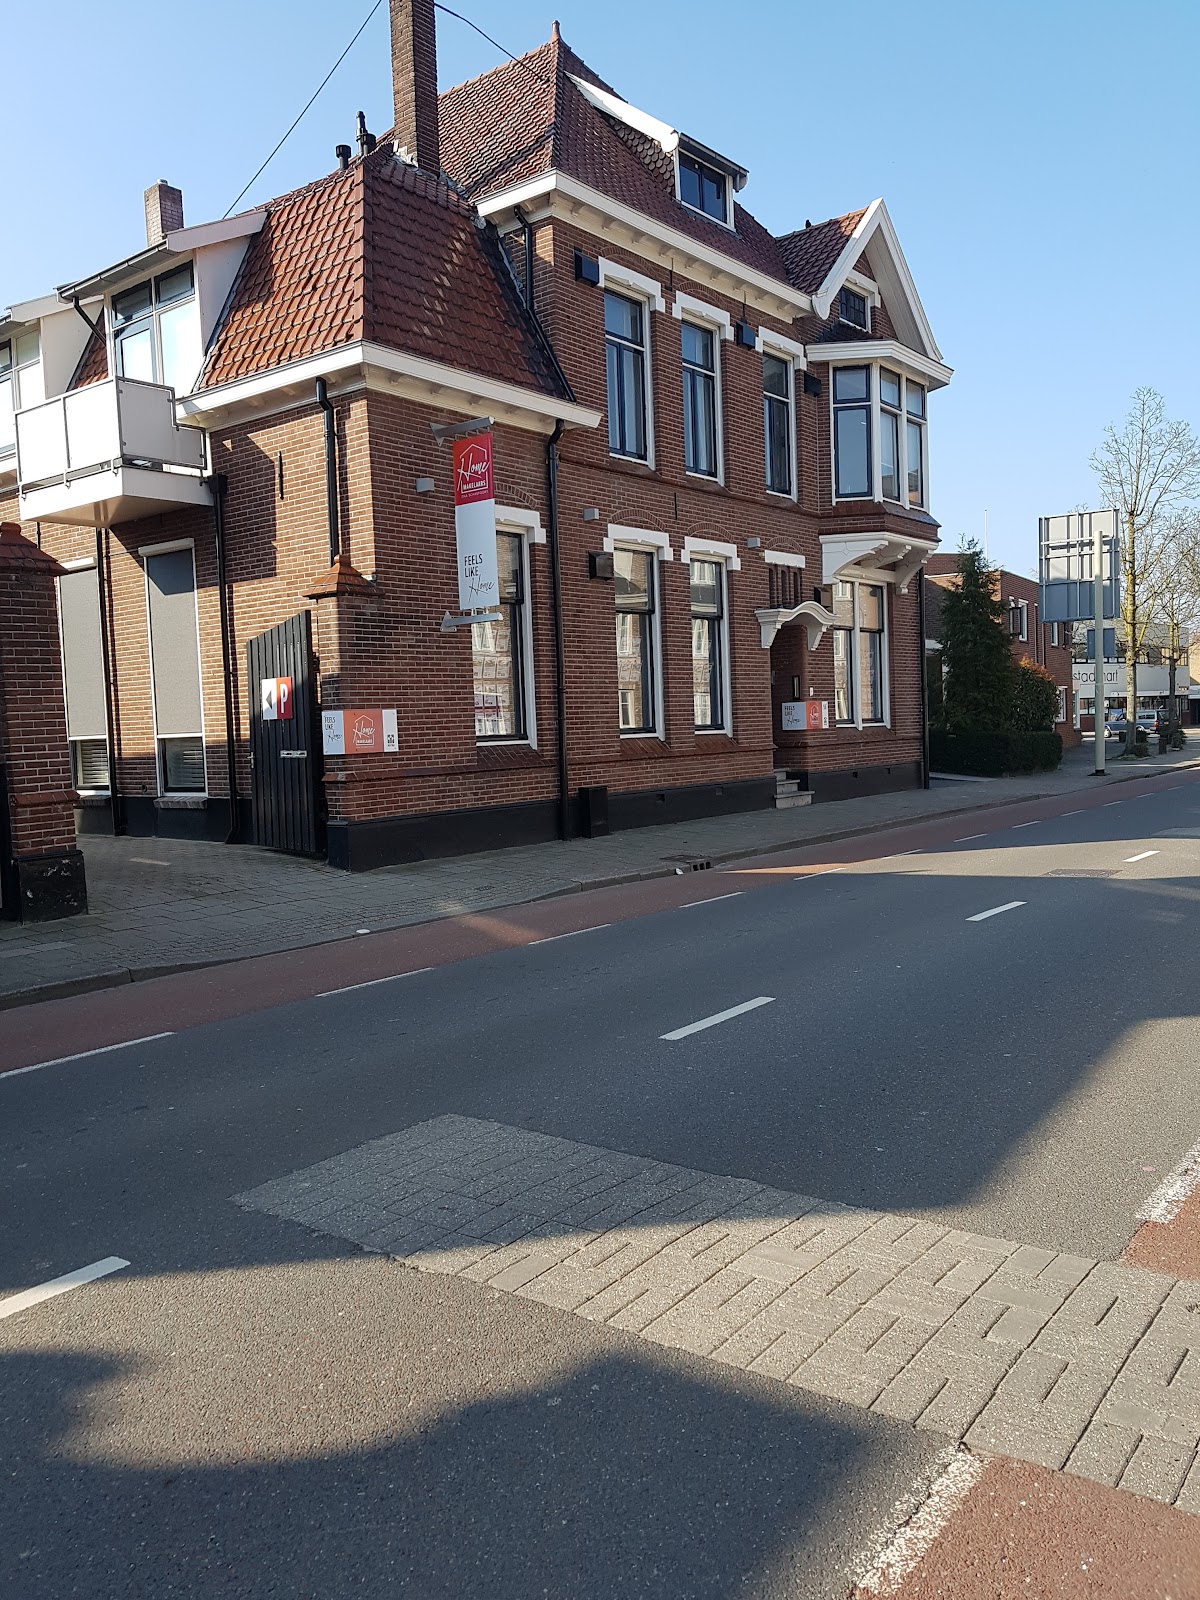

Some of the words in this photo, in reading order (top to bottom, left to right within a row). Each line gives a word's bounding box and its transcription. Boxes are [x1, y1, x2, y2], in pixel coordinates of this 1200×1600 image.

[457, 453, 490, 491] Home
[464, 553, 483, 566] FEELS
[464, 566, 479, 578] LIKE
[468, 574, 495, 603] Home
[280, 683, 288, 713] P
[353, 720, 375, 743] Home
